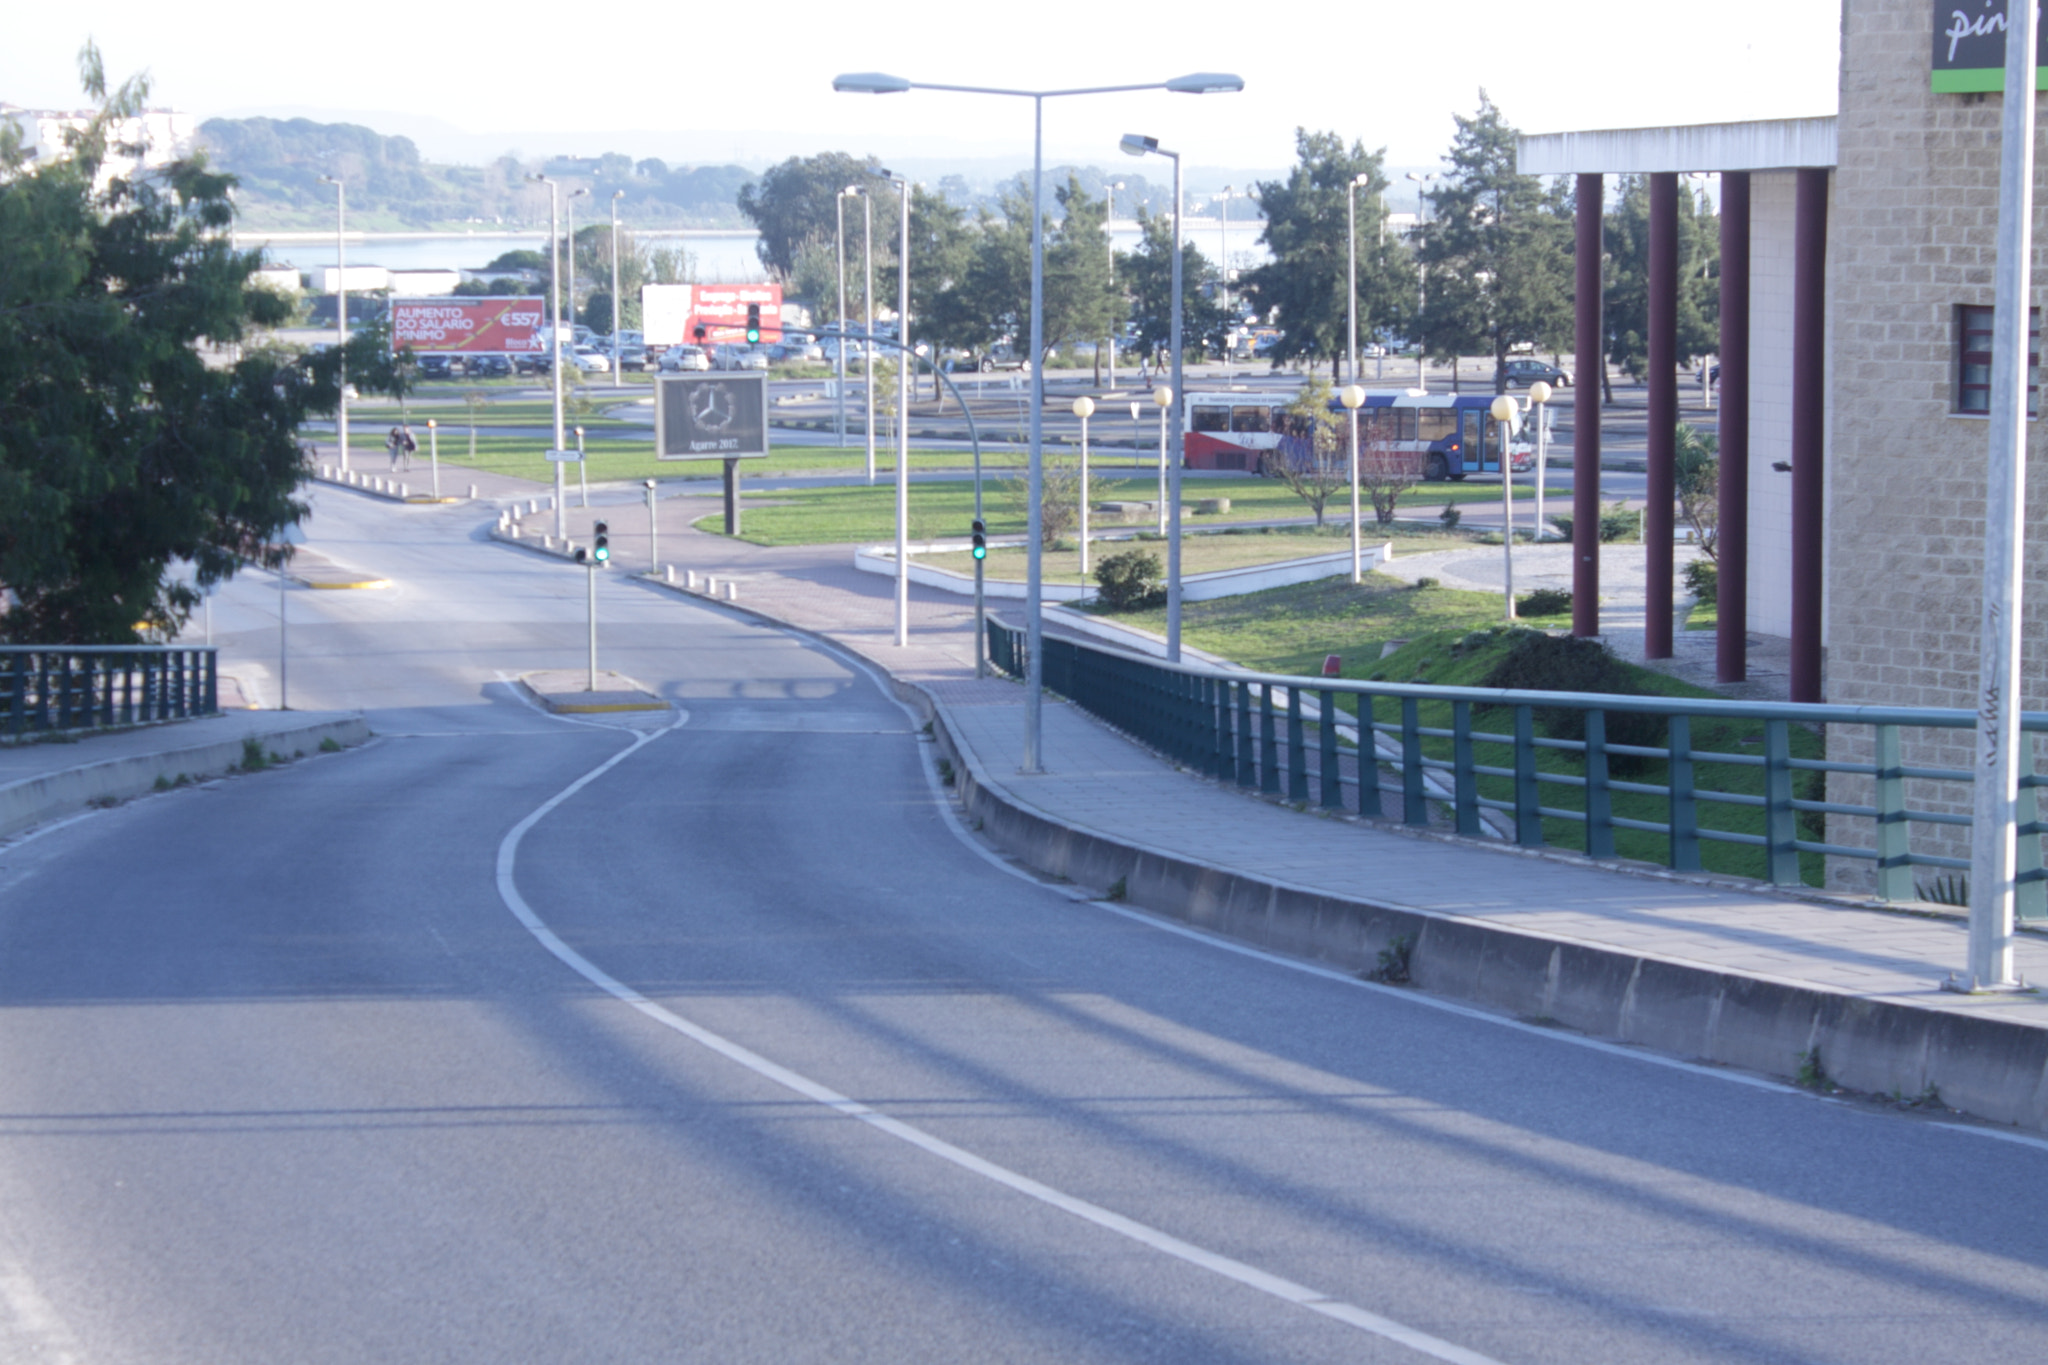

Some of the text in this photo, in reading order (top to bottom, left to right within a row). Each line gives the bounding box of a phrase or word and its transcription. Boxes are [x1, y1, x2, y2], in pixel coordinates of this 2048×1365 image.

[396, 307, 463, 319] AUMENTO
[395, 318, 418, 330] DO
[501, 312, 540, 327] €557
